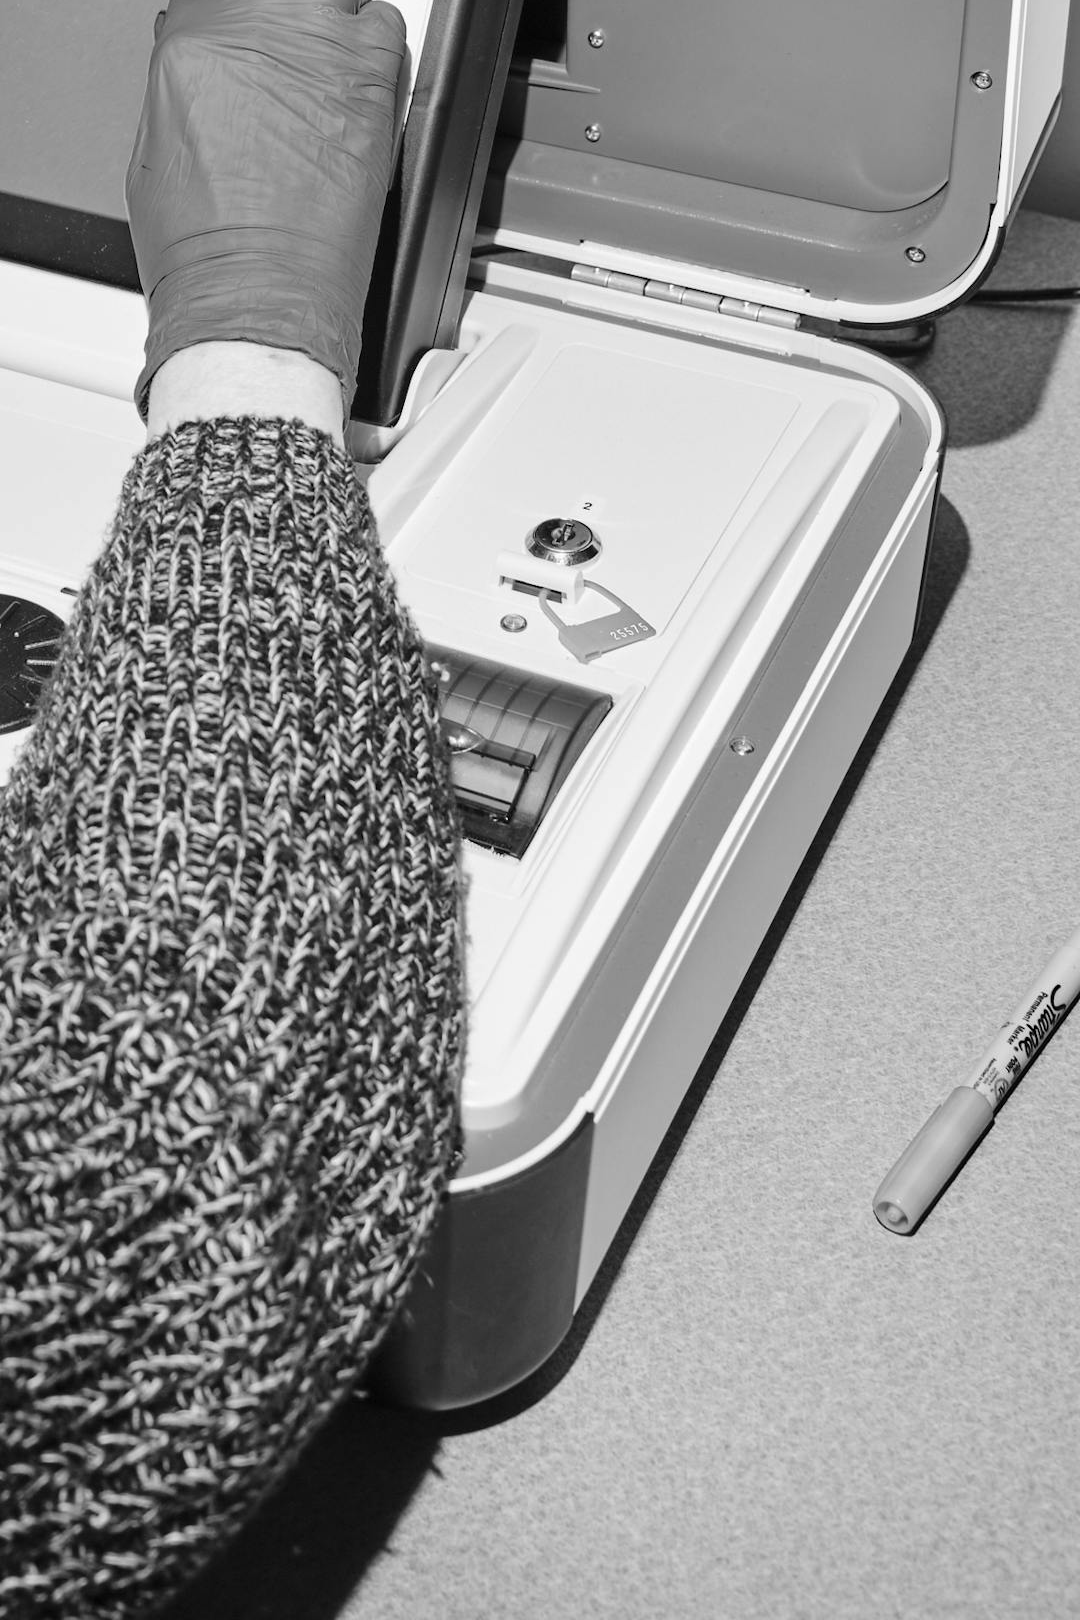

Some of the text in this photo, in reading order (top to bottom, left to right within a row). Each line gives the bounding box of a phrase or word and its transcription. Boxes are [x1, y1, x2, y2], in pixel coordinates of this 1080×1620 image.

[583, 502, 593, 511] 2
[610, 622, 649, 641] 25575
[1006, 991, 1049, 1045] Permanent Marker
